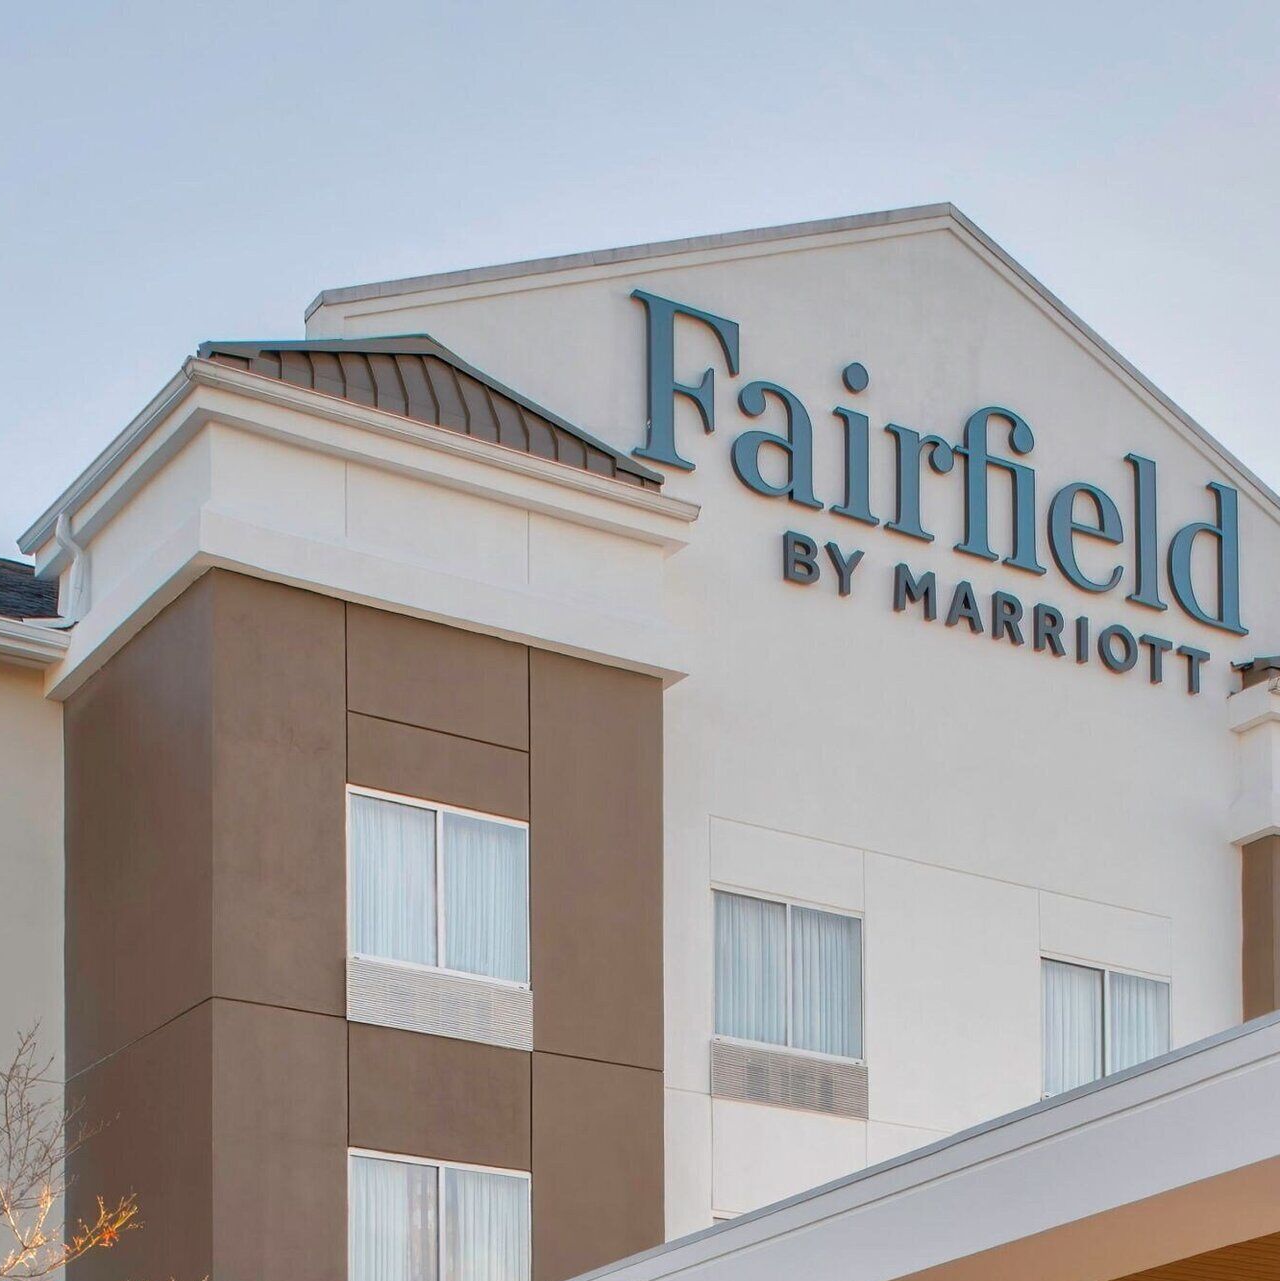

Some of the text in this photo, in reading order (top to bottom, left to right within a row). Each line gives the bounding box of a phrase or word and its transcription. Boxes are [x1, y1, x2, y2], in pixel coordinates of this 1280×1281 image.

[630, 288, 1250, 637] Fairfield
[782, 529, 1210, 694] BY MARRIOTT
